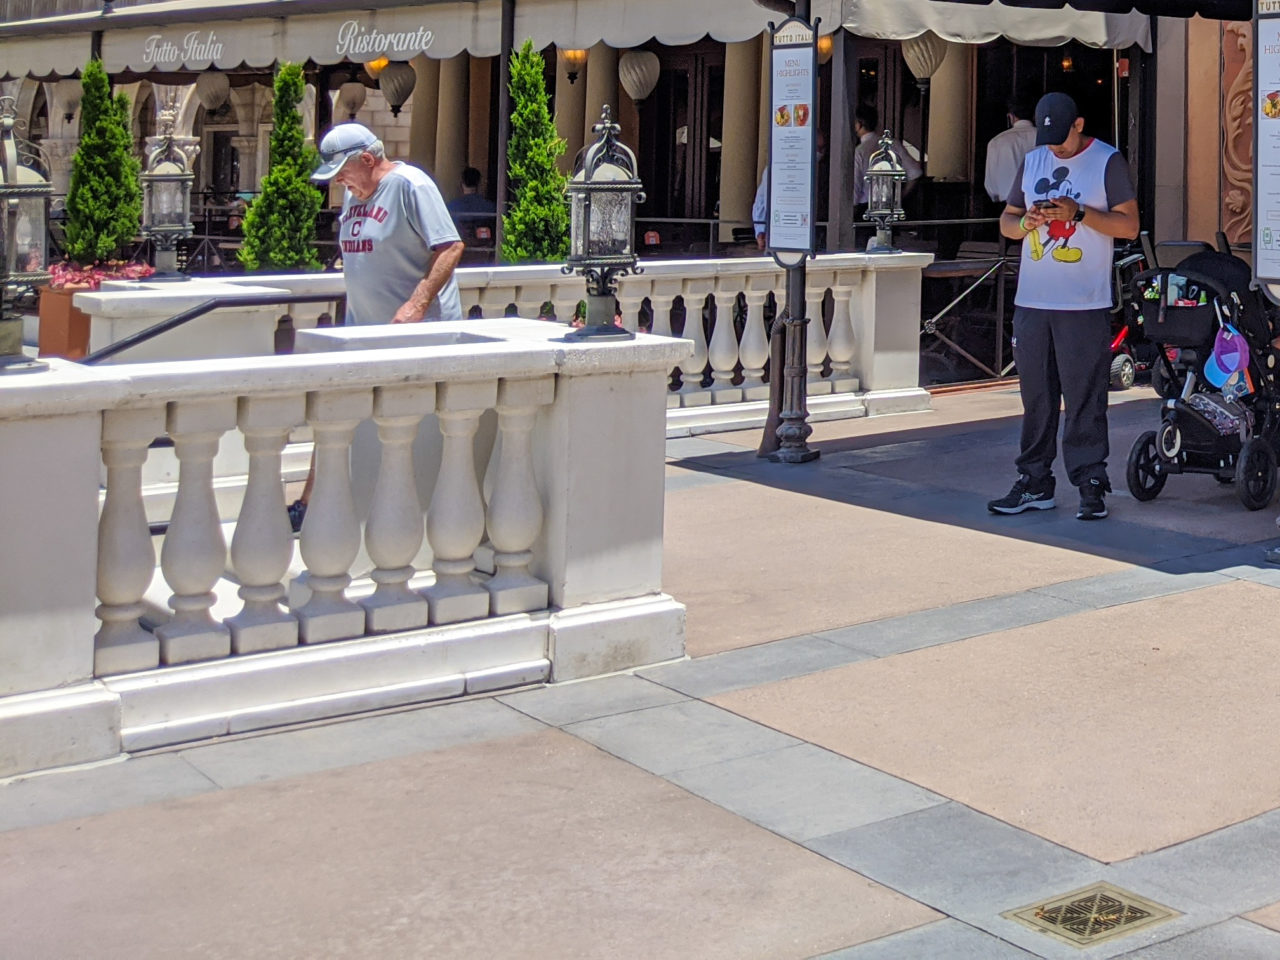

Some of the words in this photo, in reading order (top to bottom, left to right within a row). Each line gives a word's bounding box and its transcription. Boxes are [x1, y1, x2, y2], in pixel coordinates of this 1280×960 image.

[336, 19, 435, 54] Ristorante
[775, 34, 793, 43] TUTTO
[143, 34, 180, 63] Tutto
[181, 30, 224, 61] Italia
[785, 59, 800, 67] MENU
[351, 220, 362, 237] C
